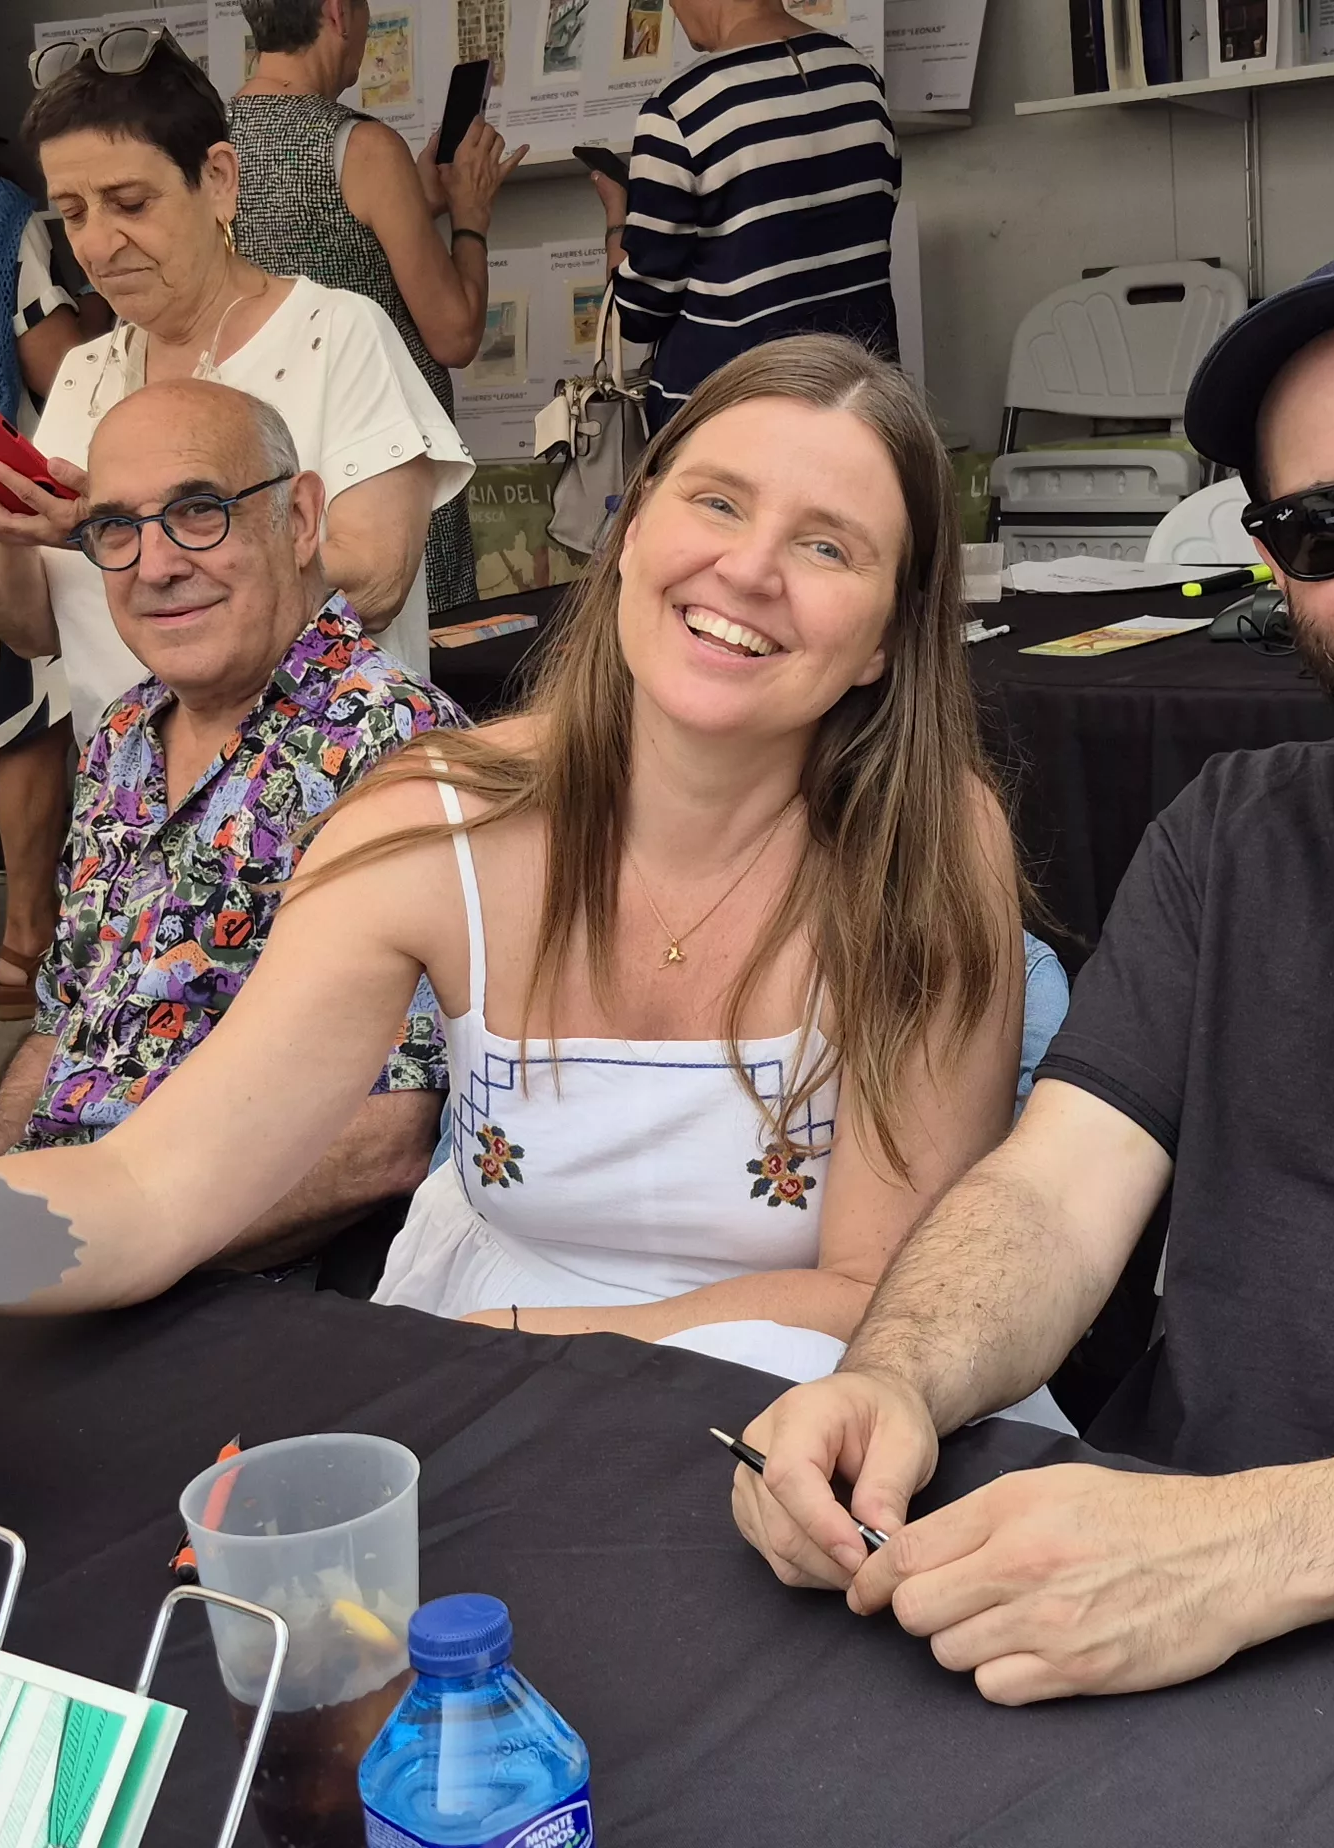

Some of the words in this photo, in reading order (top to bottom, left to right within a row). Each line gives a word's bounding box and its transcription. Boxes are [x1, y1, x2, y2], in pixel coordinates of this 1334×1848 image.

[884, 27, 907, 38] ERES
[559, 90, 580, 99] "LEON
[550, 250, 583, 260] MUJERES
[584, 248, 607, 257] LECTO
[550, 261, 567, 272] ¿Por
[468, 484, 498, 505] RIA
[504, 484, 540, 505] DEL
[469, 510, 506, 524] UESCA
[524, 1811, 576, 1848] MONTE
